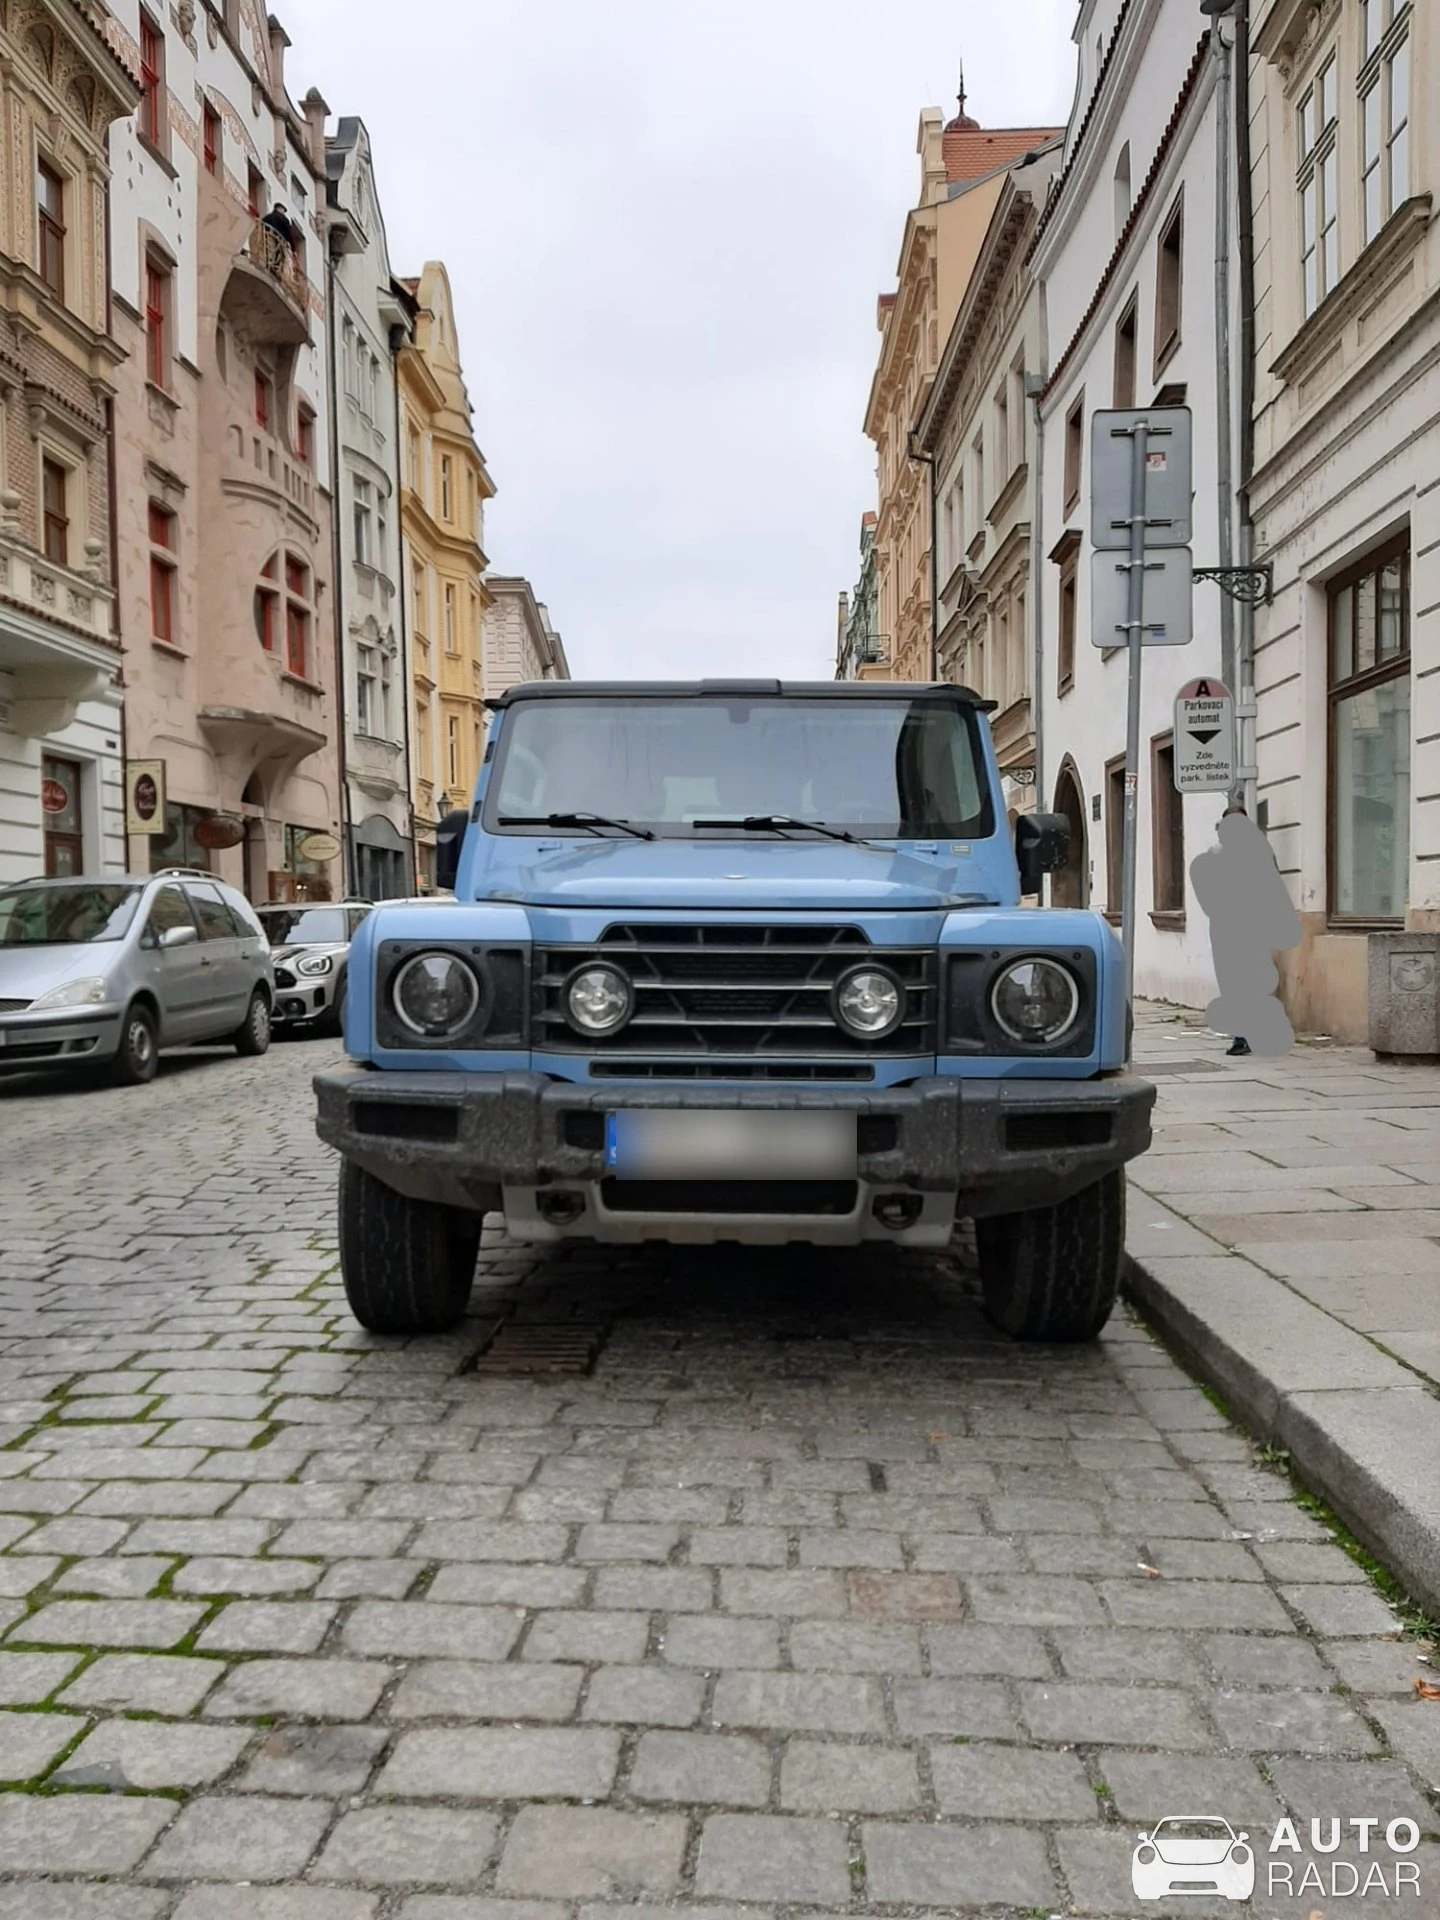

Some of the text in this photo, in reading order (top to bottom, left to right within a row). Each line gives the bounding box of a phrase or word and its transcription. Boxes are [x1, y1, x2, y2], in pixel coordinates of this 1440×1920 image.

[1195, 680, 1211, 697] A
[1188, 713, 1220, 724] automat
[1196, 751, 1213, 760] Zde
[1180, 761, 1230, 772] vyzvedněte
[1181, 774, 1203, 784] park.
